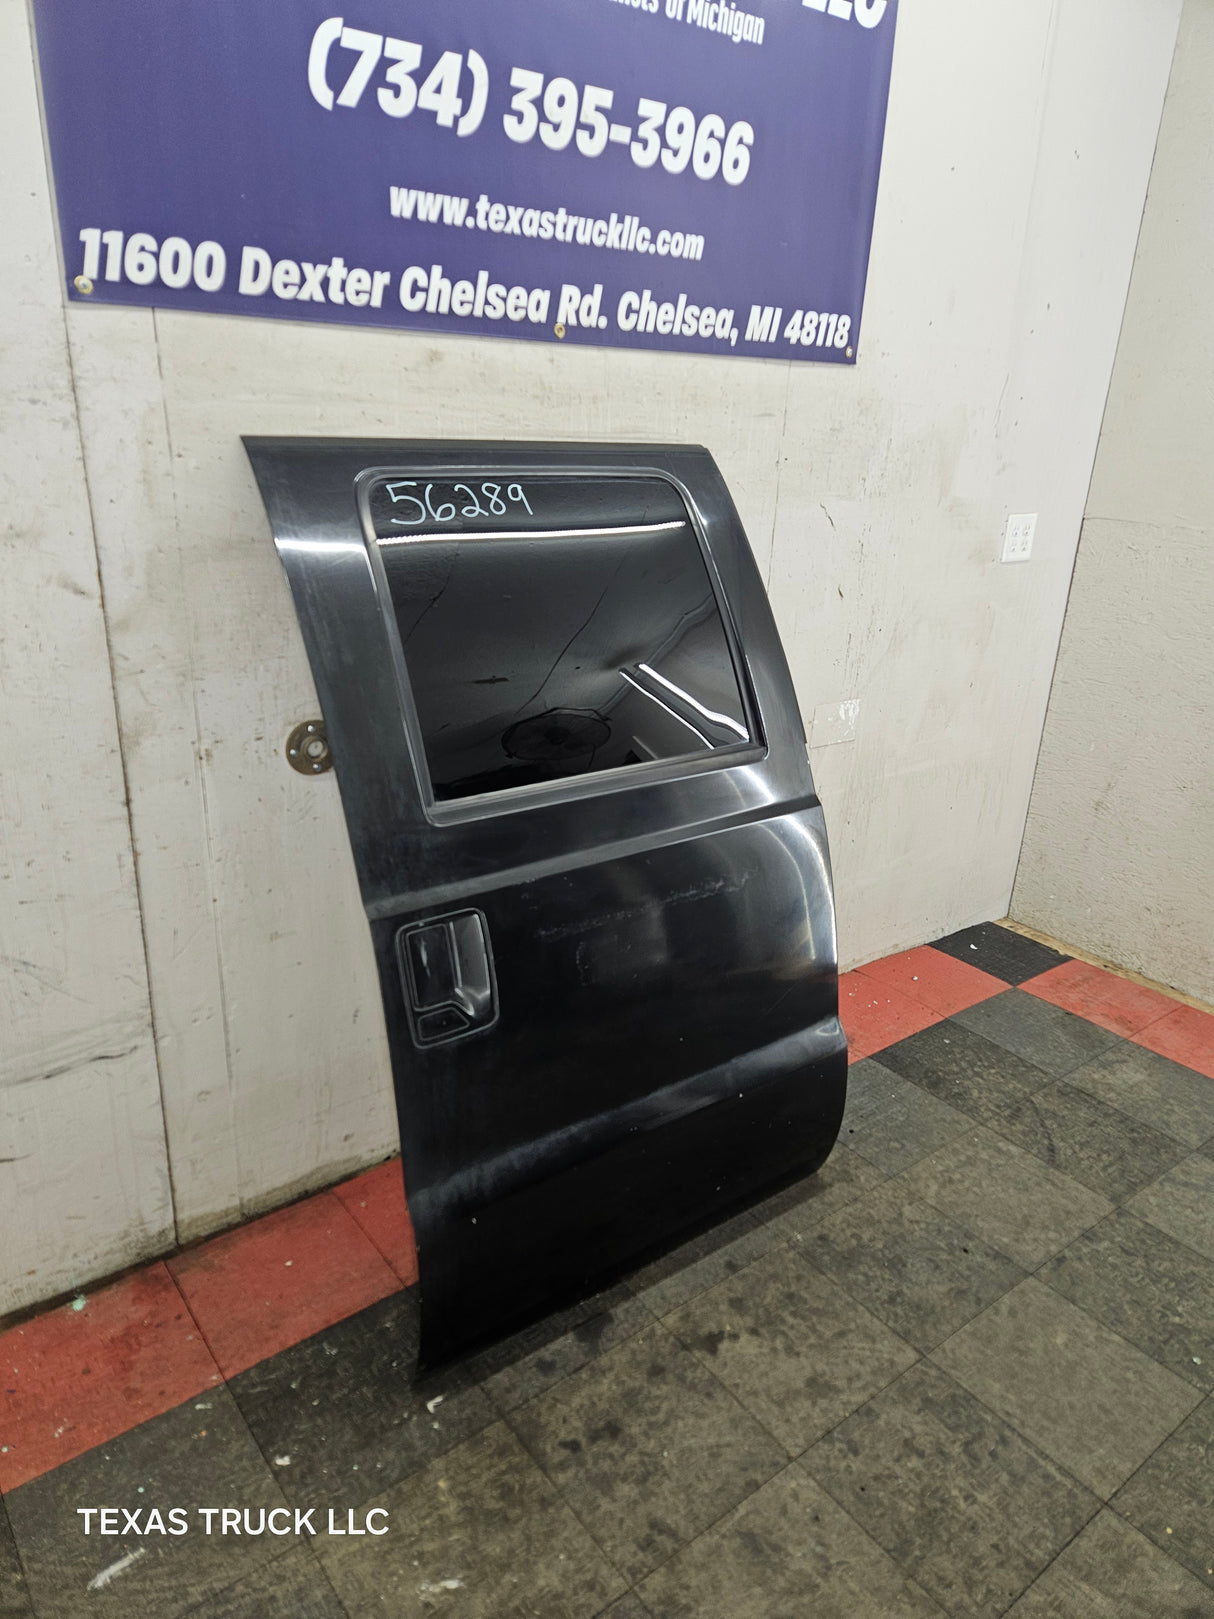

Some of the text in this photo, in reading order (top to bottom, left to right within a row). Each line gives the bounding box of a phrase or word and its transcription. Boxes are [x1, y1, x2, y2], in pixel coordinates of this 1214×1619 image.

[687, 0, 765, 45] Michigan
[308, 17, 755, 186] (734) 395-3966
[389, 186, 705, 261] www.texastruckllc.com
[79, 227, 852, 349] 11600 Dexter Chelsea Rd. Chelsea, MI 48118
[386, 481, 534, 525] 56289
